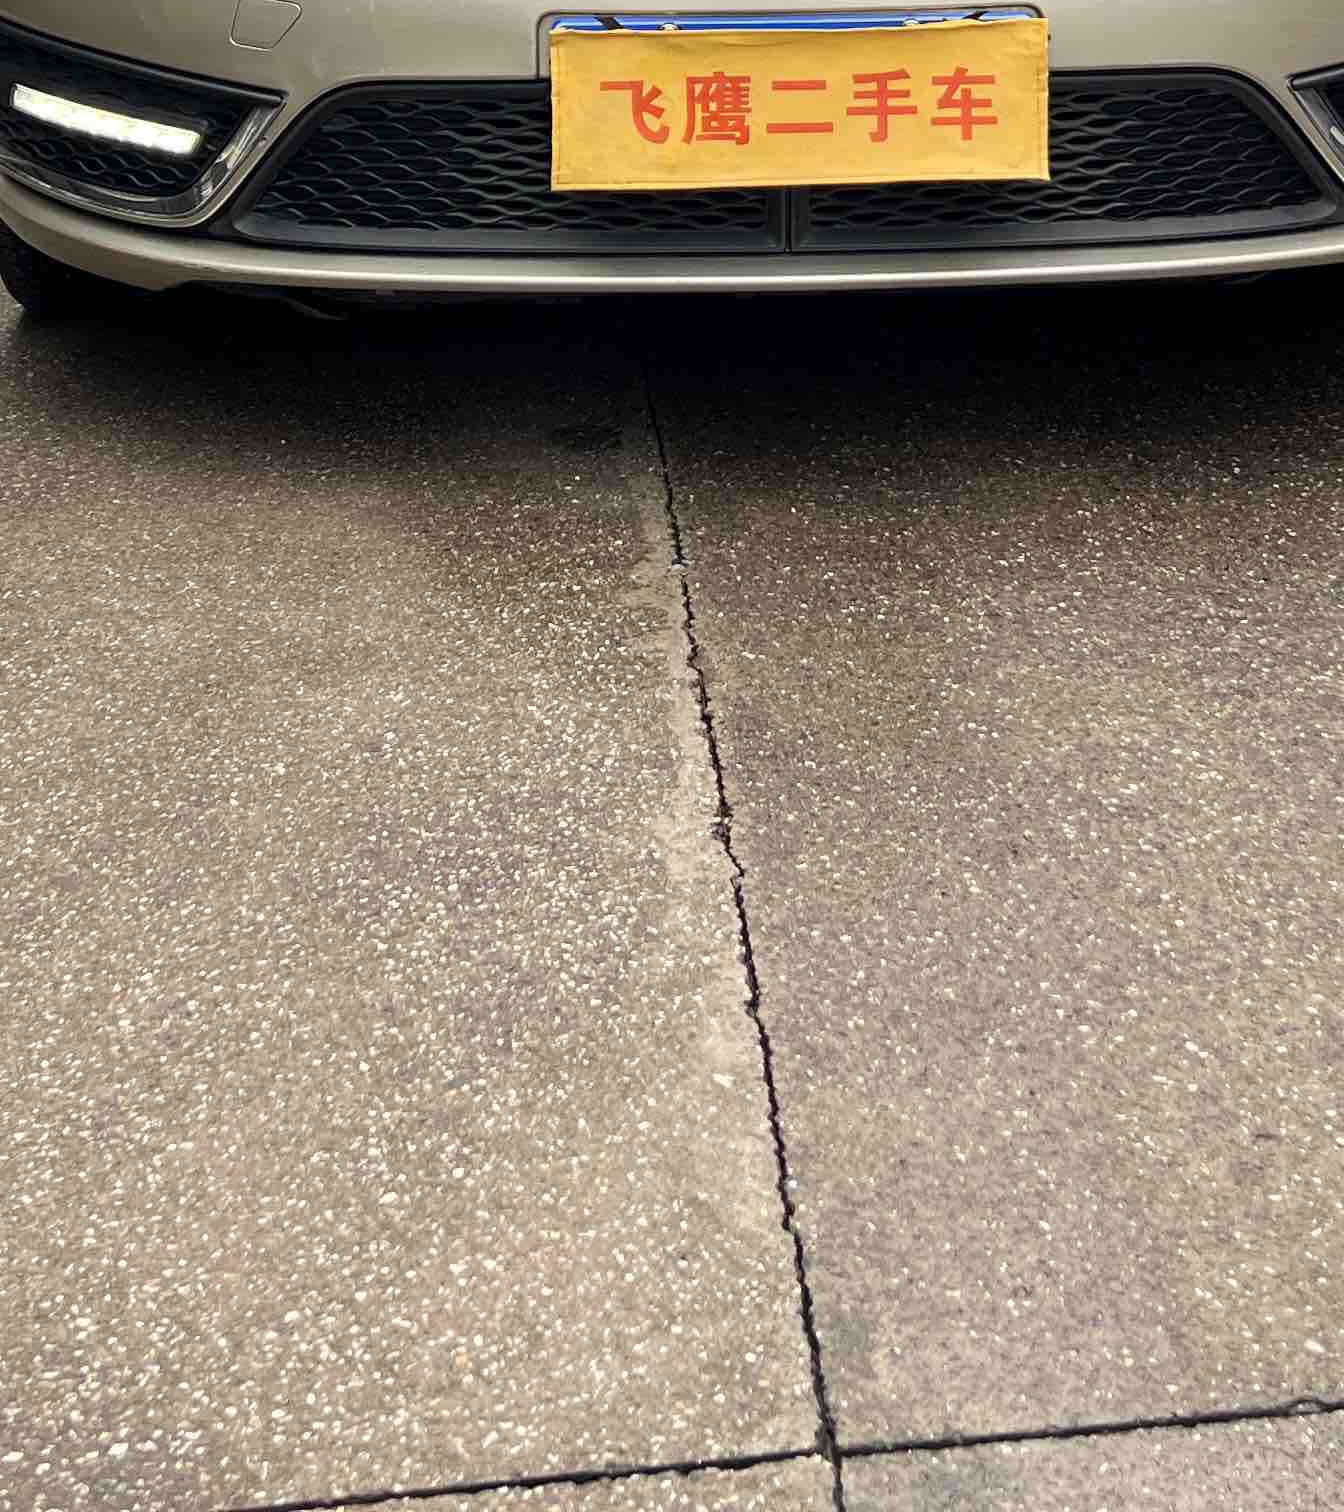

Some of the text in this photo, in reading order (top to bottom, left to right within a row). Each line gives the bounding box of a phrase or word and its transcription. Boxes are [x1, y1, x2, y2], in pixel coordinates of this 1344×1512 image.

[599, 66, 999, 147] 飞鹰二手车
